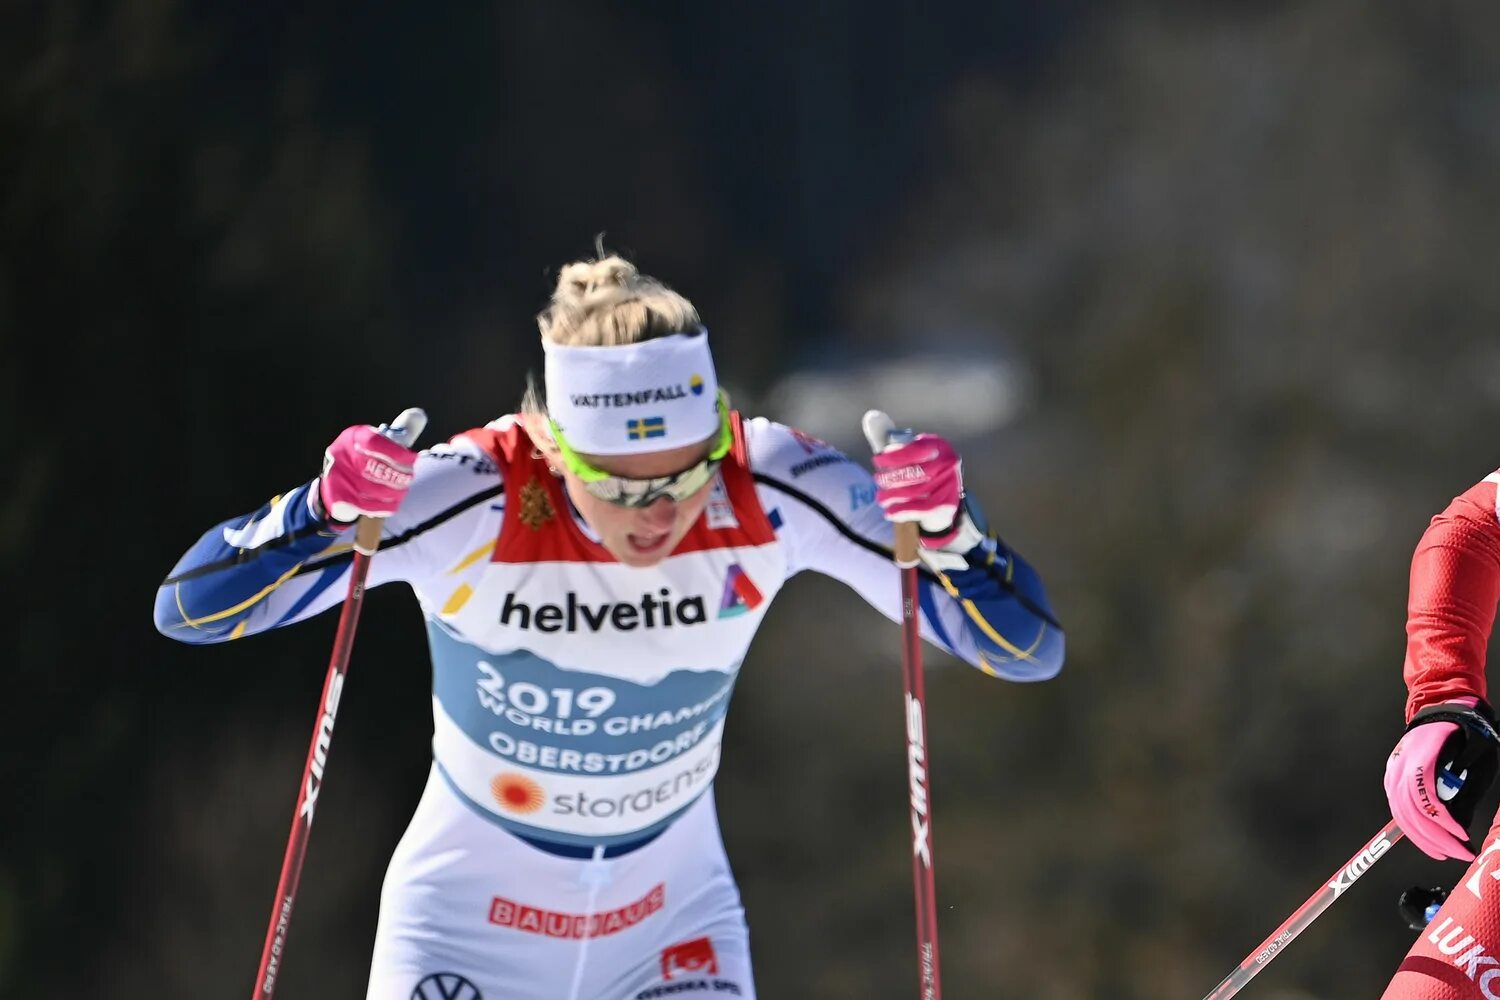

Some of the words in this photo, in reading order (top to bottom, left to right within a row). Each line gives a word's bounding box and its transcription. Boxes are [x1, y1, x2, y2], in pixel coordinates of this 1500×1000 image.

[570, 384, 688, 408] VATTENFALL
[500, 587, 708, 634] helvetia
[476, 659, 617, 719] 2019
[476, 687, 597, 737] WORLD
[488, 722, 709, 773] OBERSTDORF
[491, 884, 665, 938] BAUHAUS
